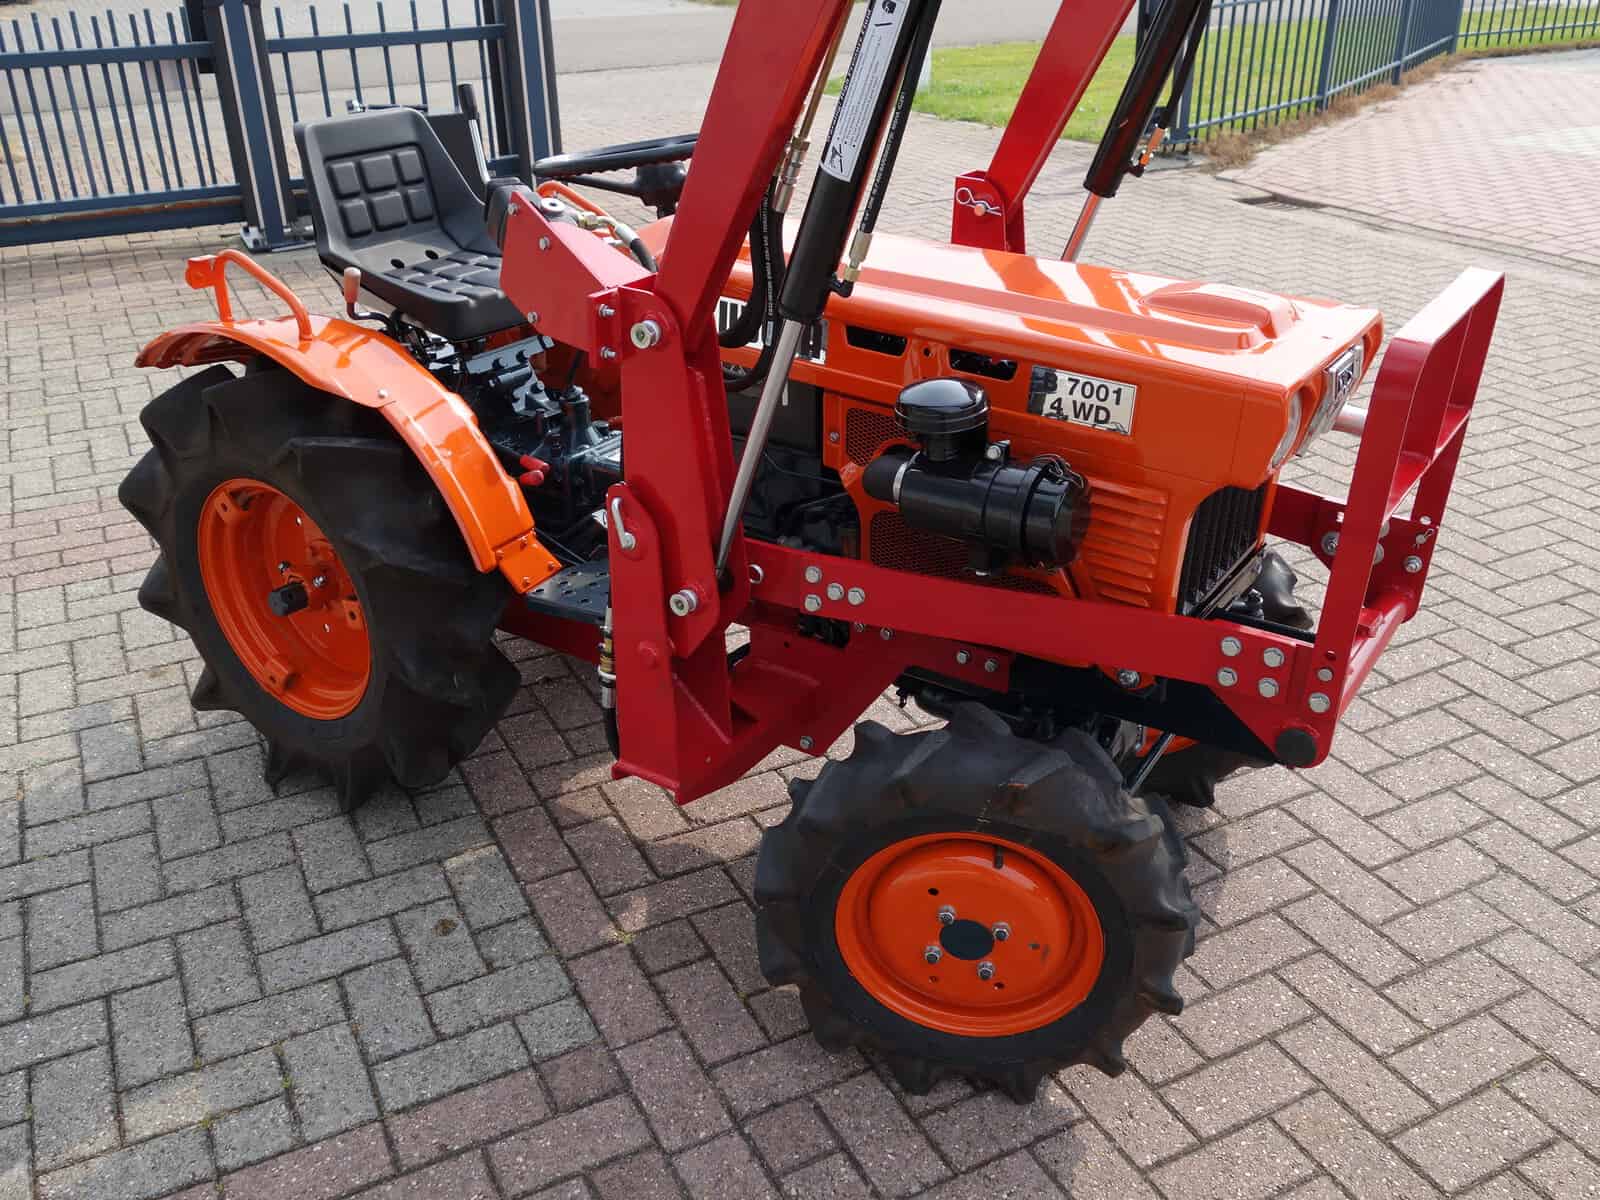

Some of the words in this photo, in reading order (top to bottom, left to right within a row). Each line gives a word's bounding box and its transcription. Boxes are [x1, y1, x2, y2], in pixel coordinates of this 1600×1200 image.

[1067, 377, 1122, 405] 7001
[1050, 397, 1064, 417] 4
[1072, 400, 1111, 424] WD
